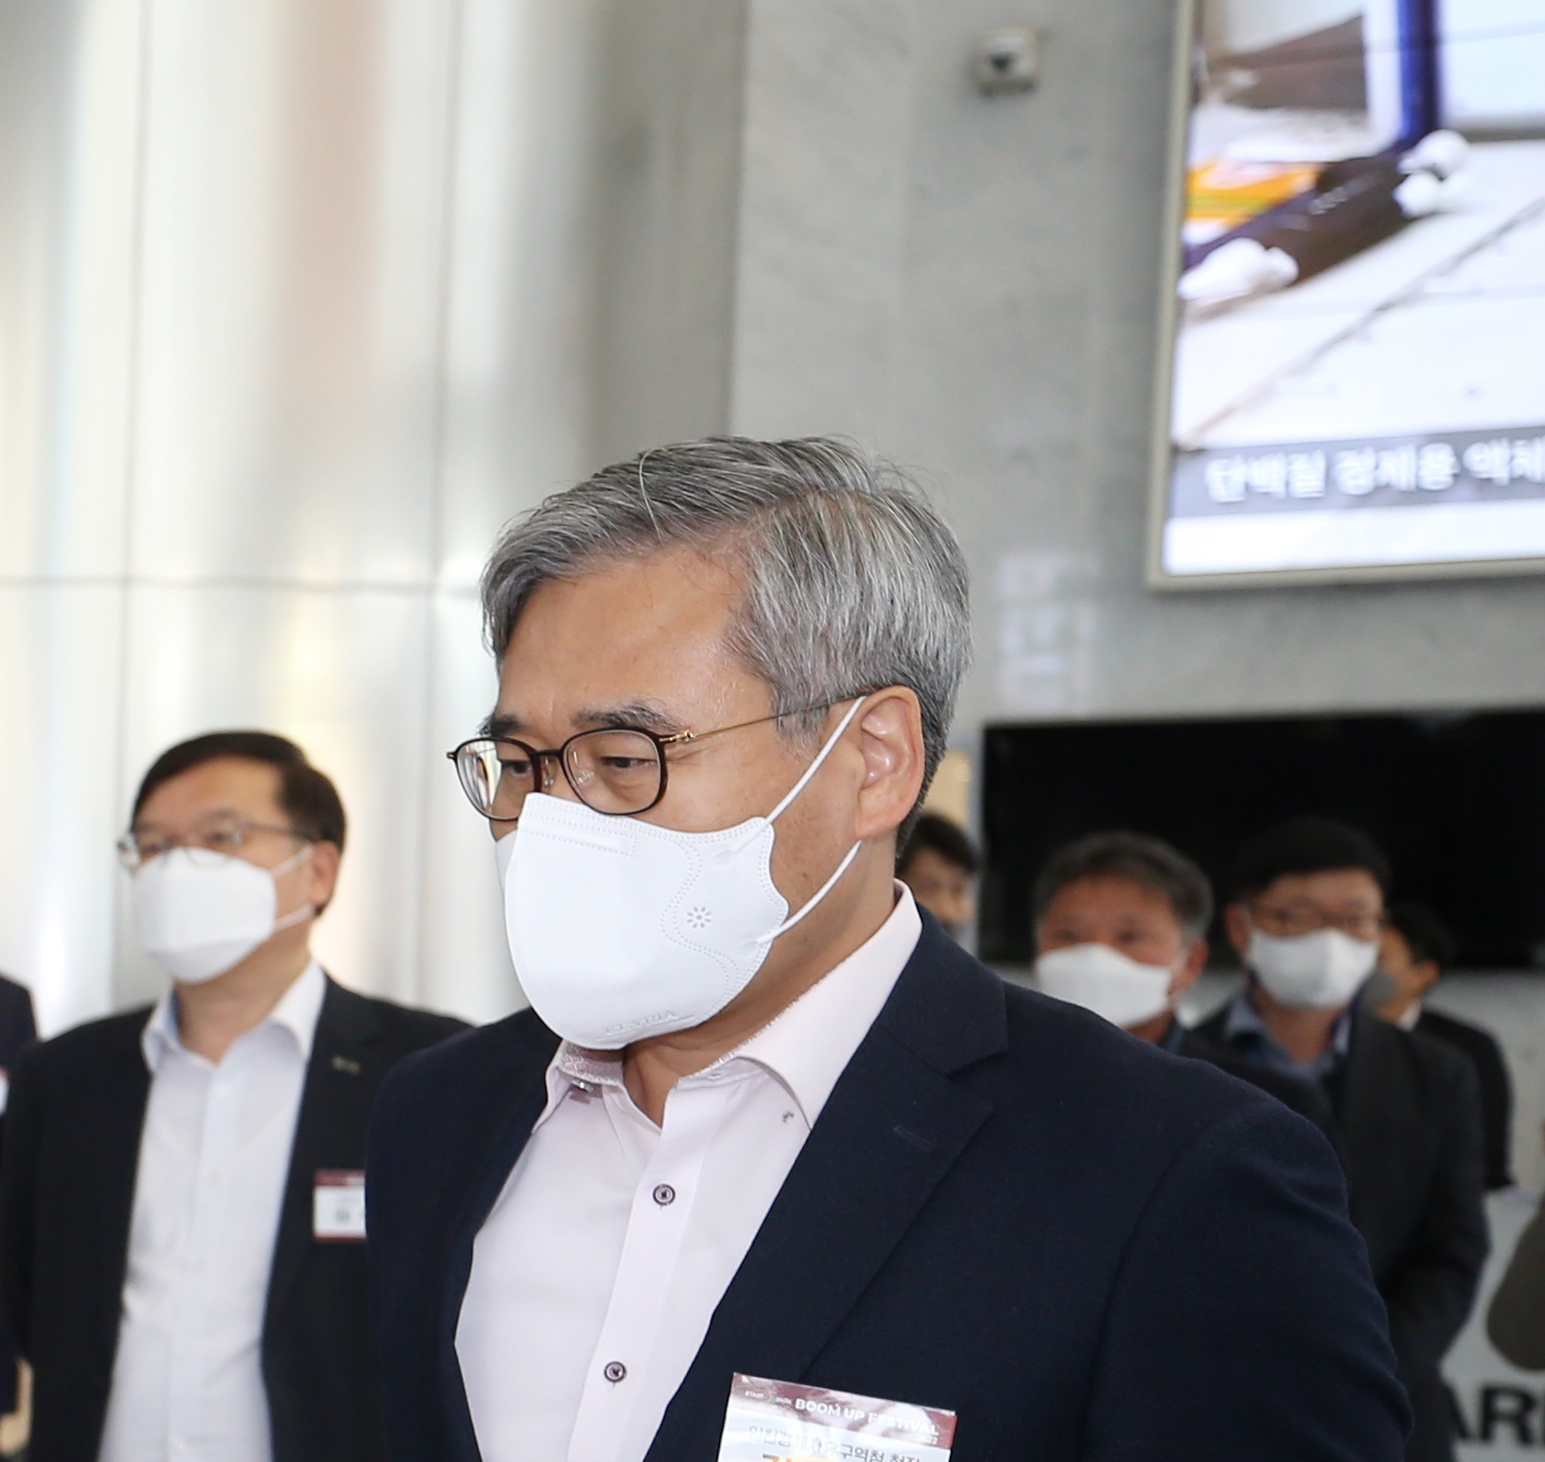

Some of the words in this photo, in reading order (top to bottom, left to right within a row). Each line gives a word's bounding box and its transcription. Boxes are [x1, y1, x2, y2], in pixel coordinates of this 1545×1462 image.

[795, 1398, 841, 1417] BOOM
[844, 1408, 865, 1421] UP
[868, 1412, 940, 1436] FESTIVAL
